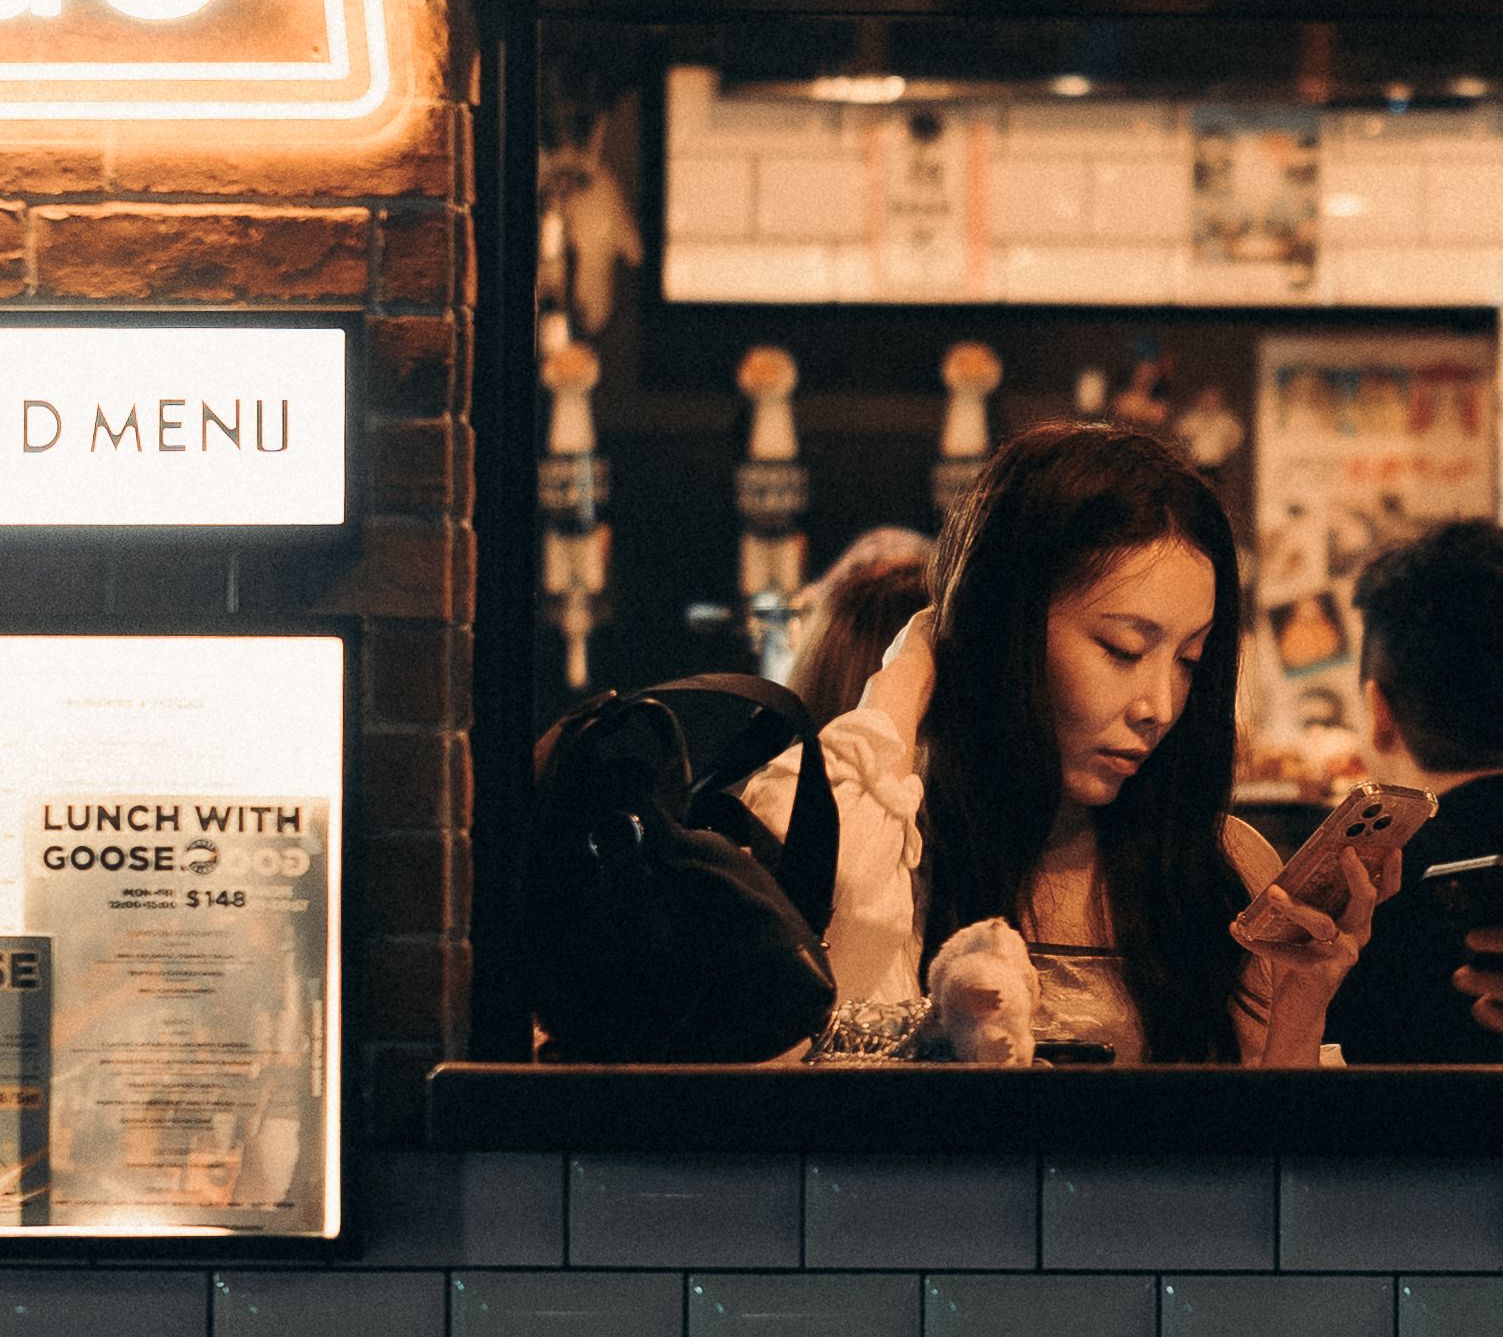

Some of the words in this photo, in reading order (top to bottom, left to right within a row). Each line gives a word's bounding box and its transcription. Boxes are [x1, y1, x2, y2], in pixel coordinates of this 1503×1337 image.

[89, 398, 290, 454] MENU
[43, 805, 180, 832] LUNCH
[194, 805, 301, 833] WITH
